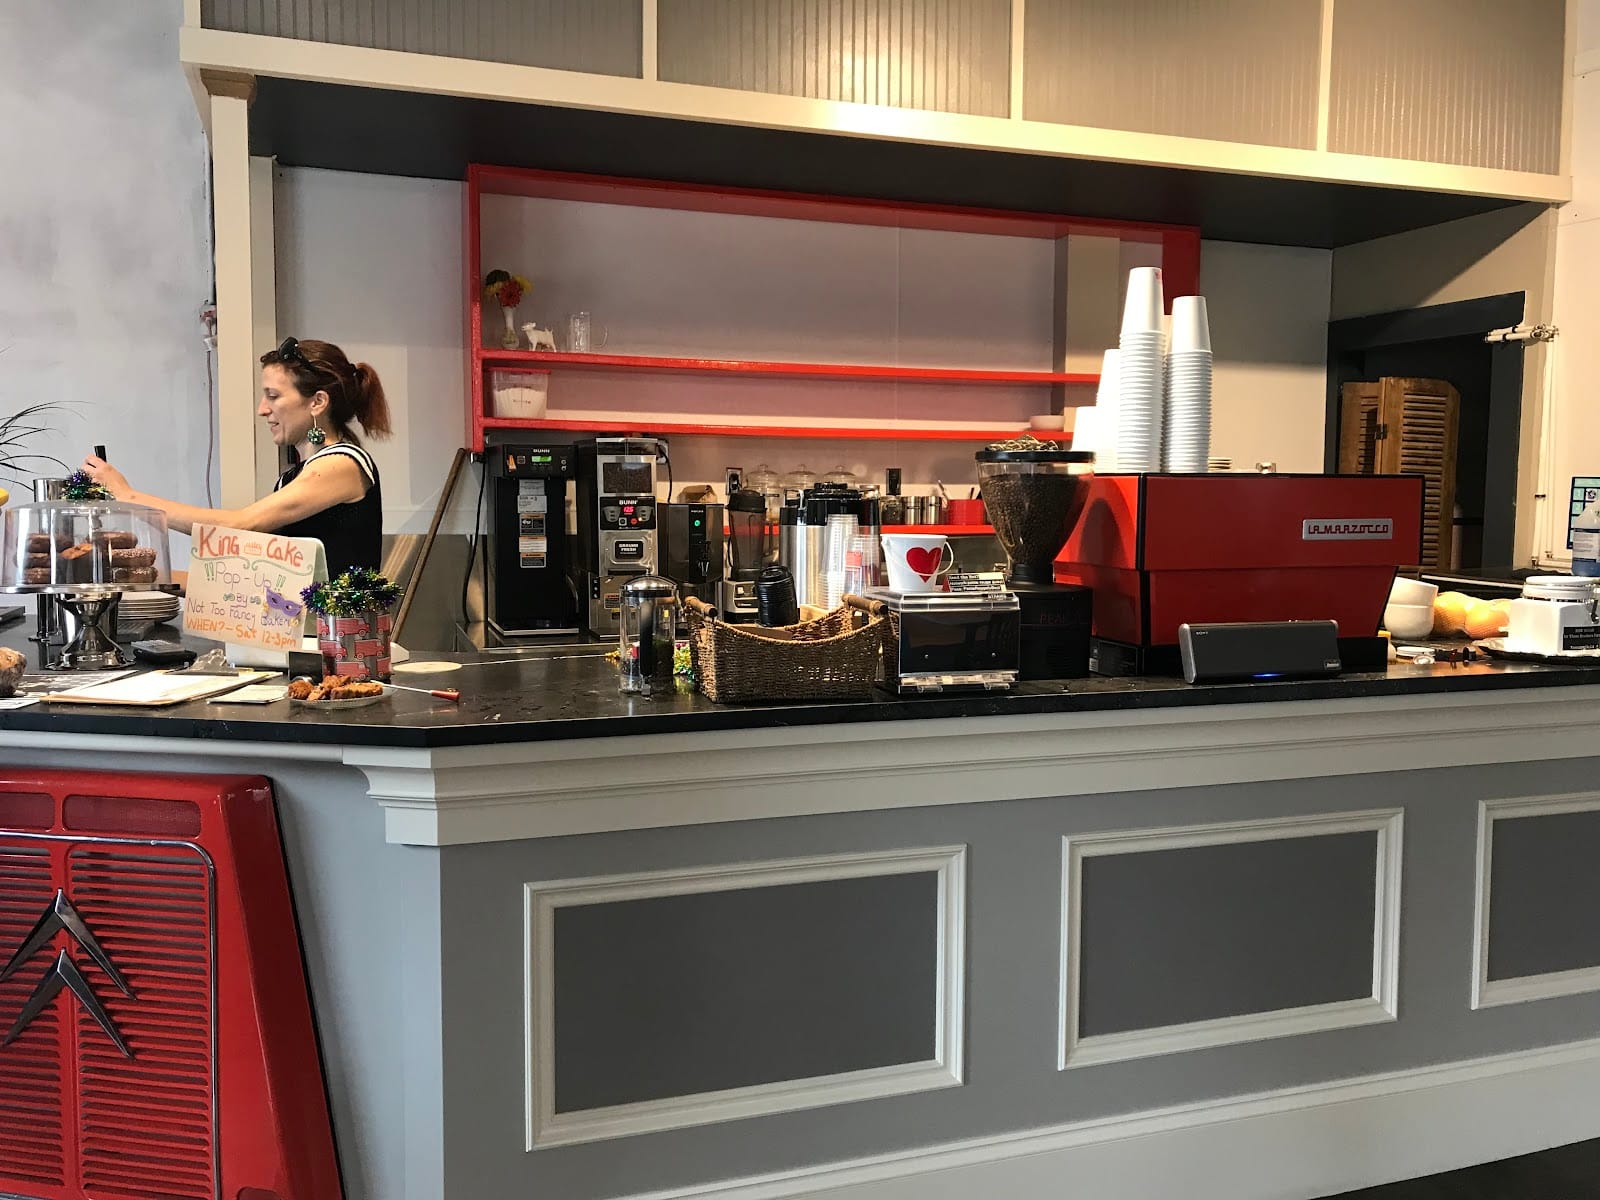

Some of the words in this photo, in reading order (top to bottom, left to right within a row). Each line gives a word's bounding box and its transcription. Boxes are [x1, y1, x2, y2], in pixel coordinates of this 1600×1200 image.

[266, 537, 304, 567] Cake
[187, 597, 205, 614] Not
[210, 602, 225, 616] Too
[229, 607, 256, 630] Fancy
[236, 624, 257, 638] Sat
